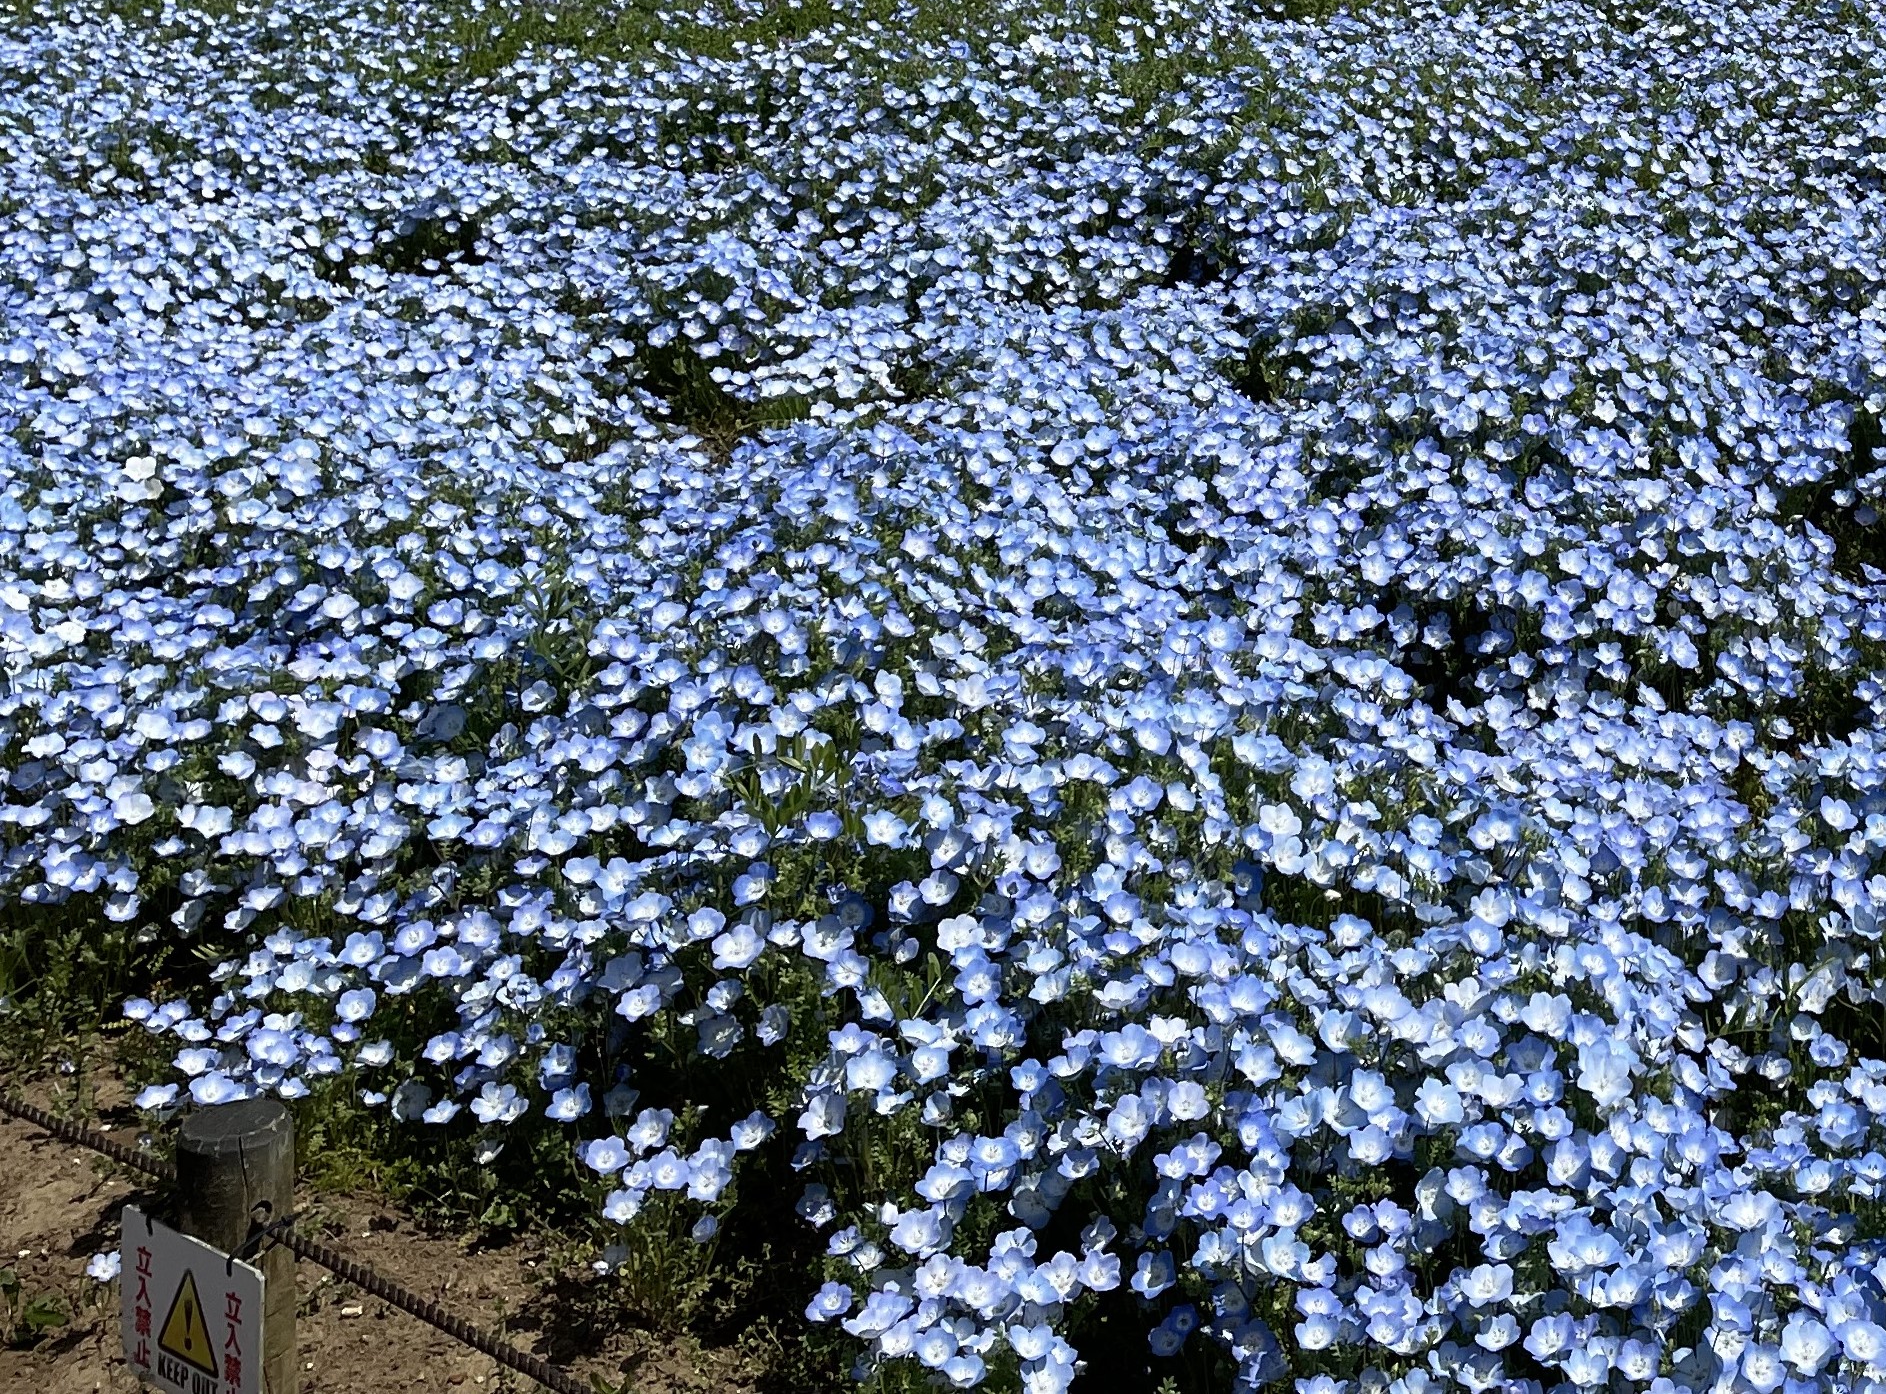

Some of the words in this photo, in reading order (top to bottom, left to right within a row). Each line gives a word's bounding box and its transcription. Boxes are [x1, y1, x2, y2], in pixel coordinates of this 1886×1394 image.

[134, 1246, 152, 1368] 立入禁止
[224, 1292, 242, 1394] 立入禁
[158, 1353, 188, 1389] KEEP
